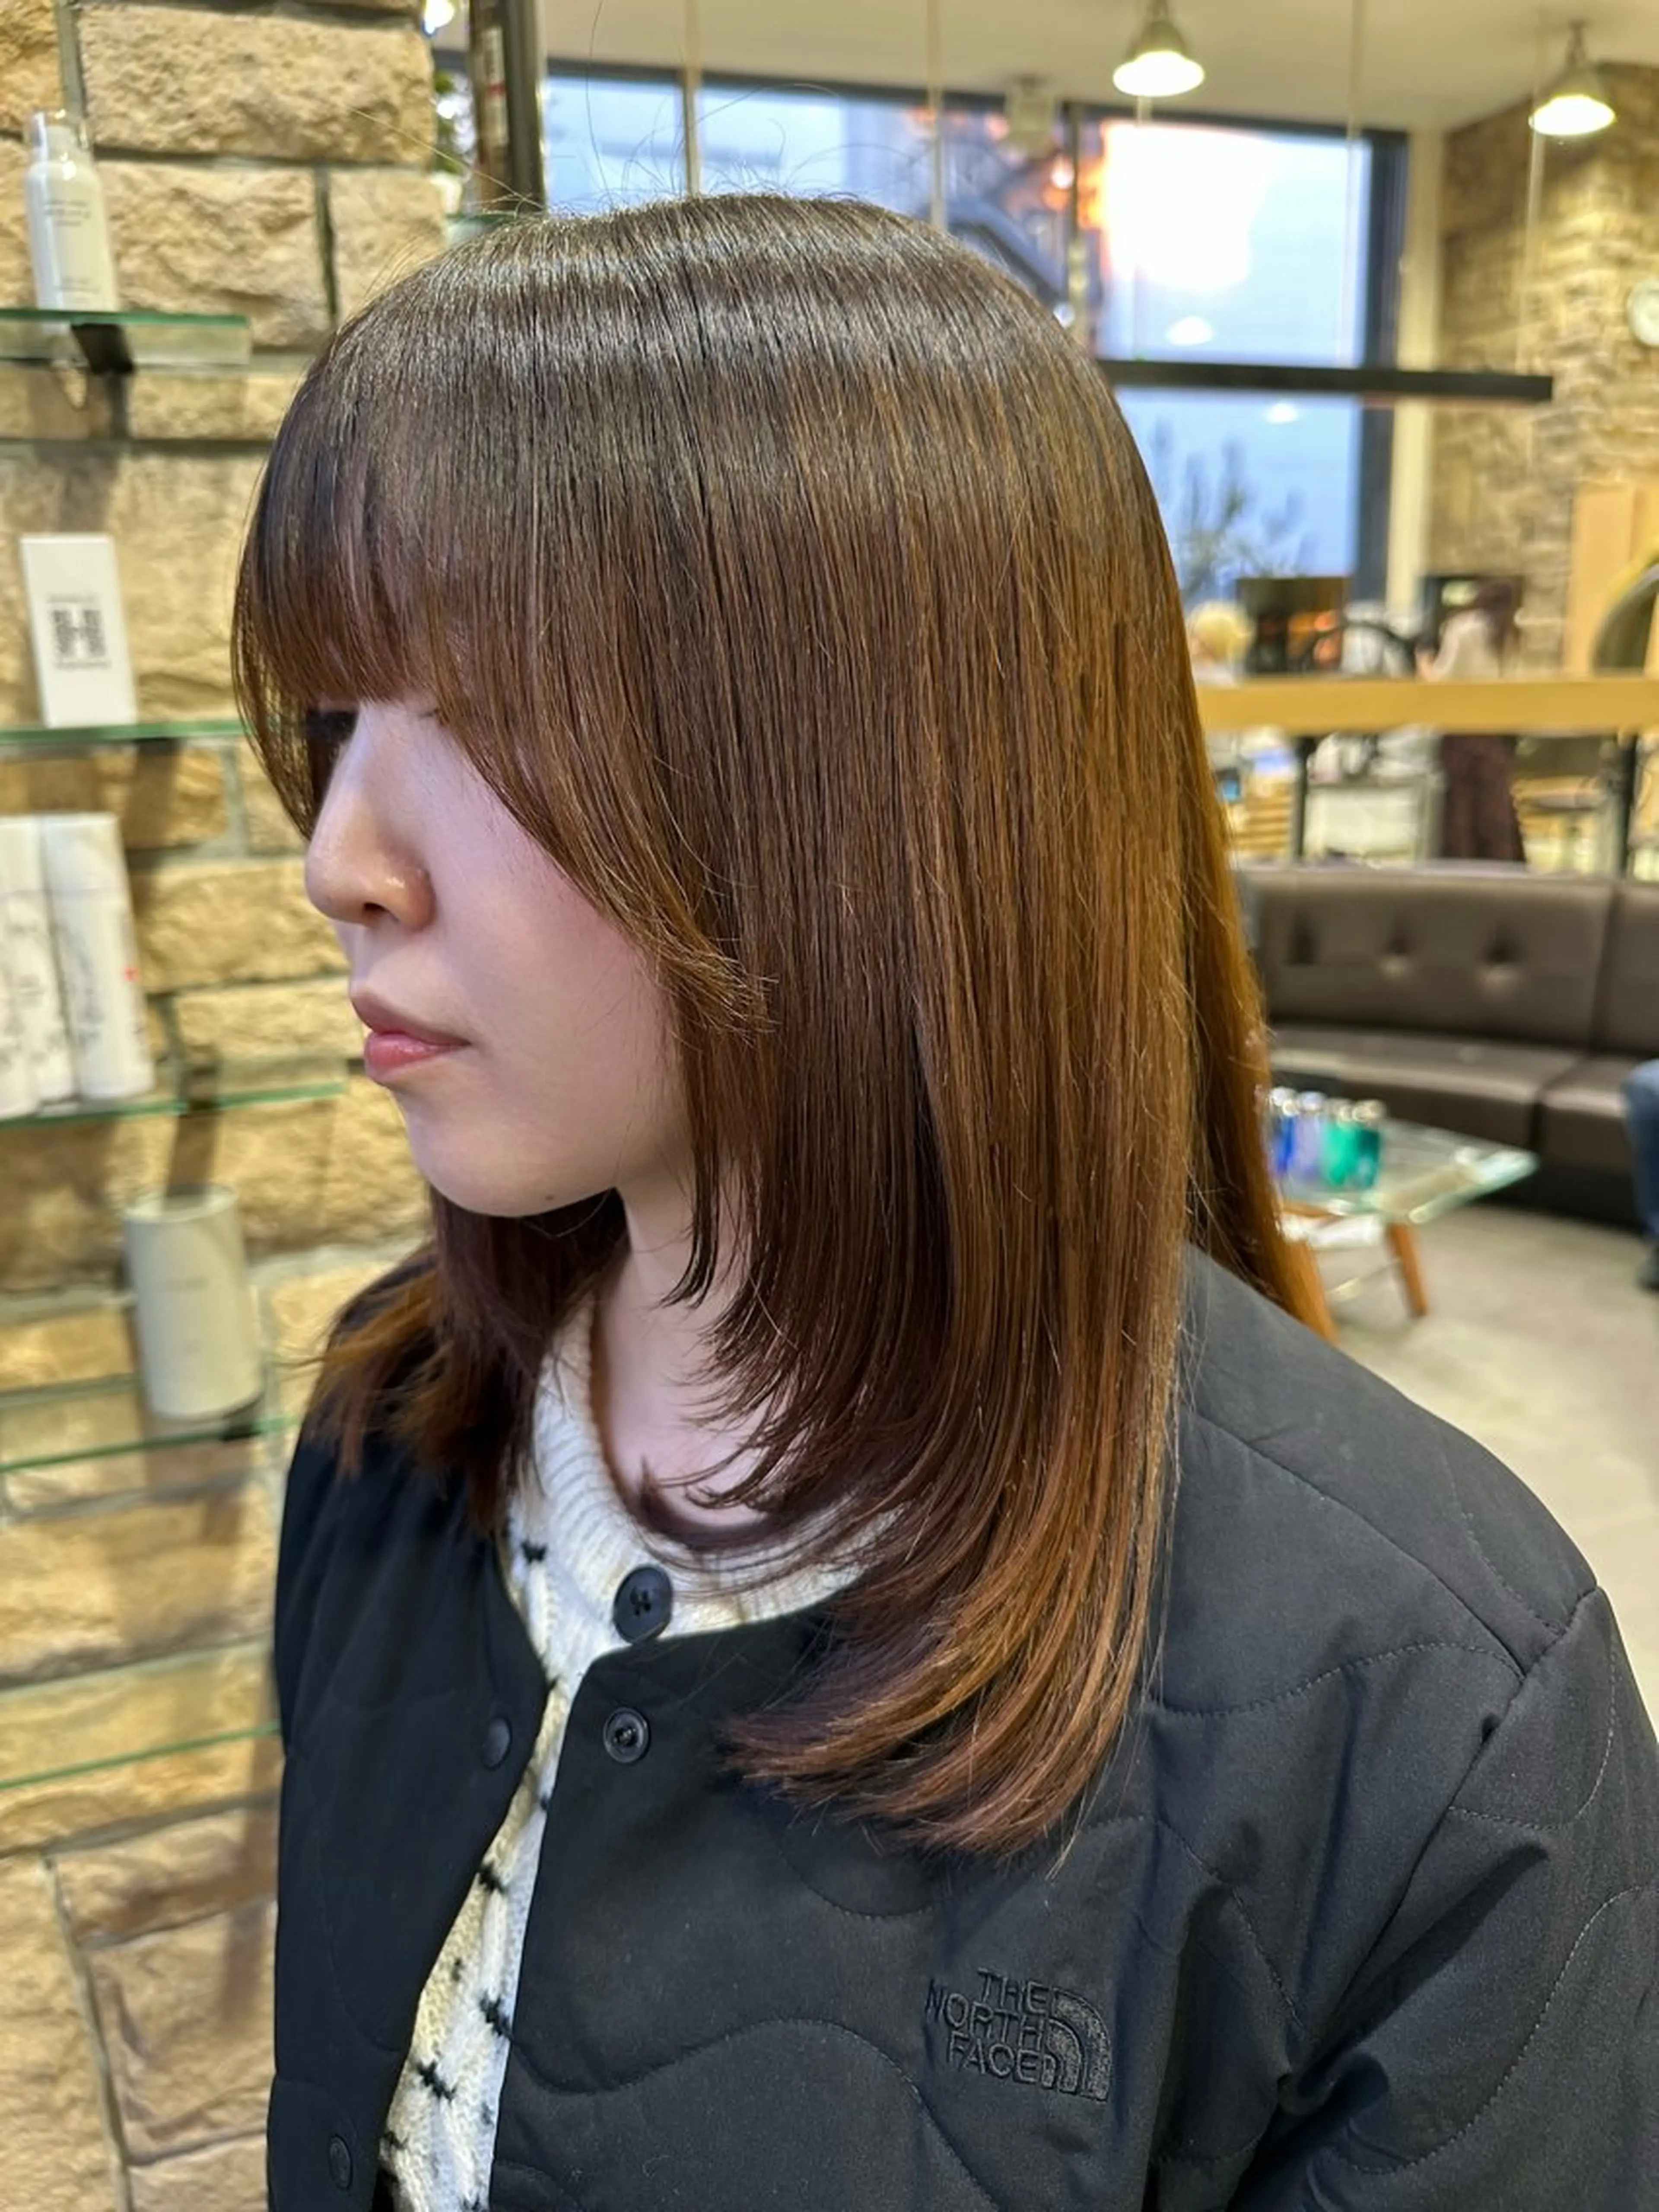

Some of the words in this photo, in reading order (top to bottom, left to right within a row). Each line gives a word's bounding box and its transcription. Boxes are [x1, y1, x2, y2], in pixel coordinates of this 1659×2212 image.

[925, 1979, 1045, 2051] NORTH
[977, 1967, 1047, 2013] THE
[946, 2030, 1040, 2083] FACE
